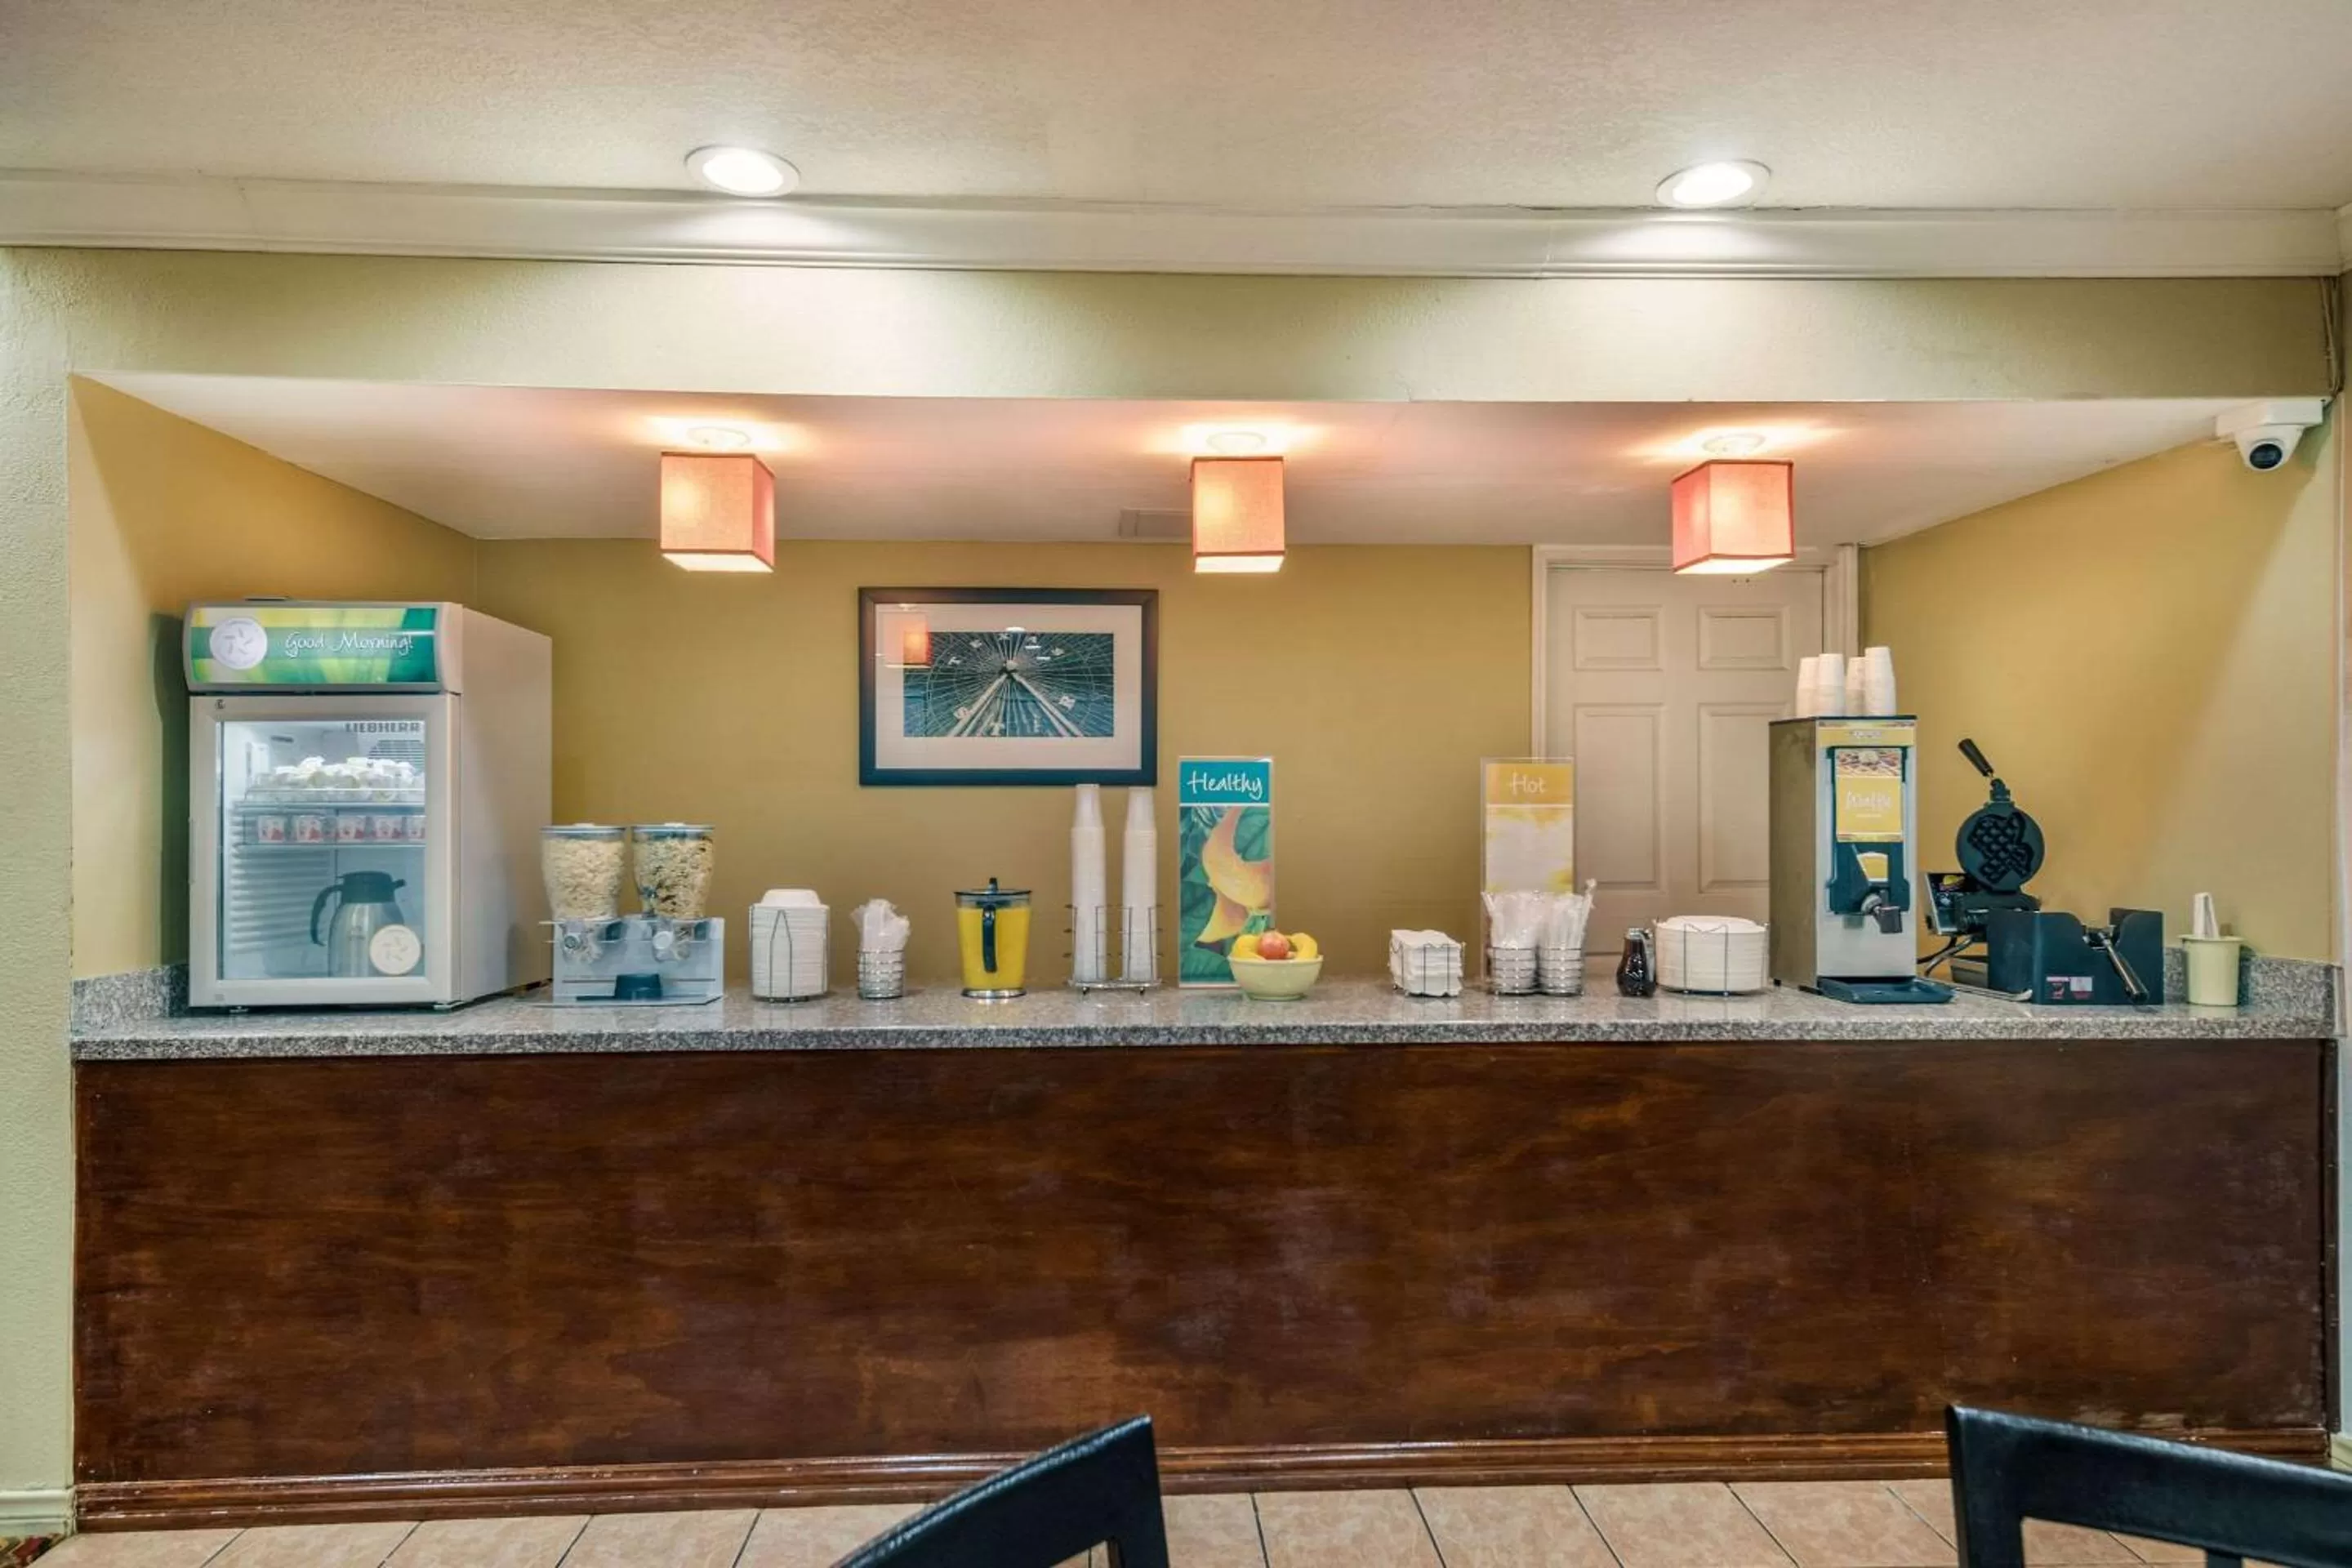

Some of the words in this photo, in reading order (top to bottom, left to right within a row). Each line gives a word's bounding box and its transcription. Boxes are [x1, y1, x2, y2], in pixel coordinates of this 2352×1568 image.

[286, 631, 324, 658] Good
[331, 631, 413, 656] Morning!
[1187, 769, 1263, 800] Healthy
[1506, 770, 1548, 796] Hot
